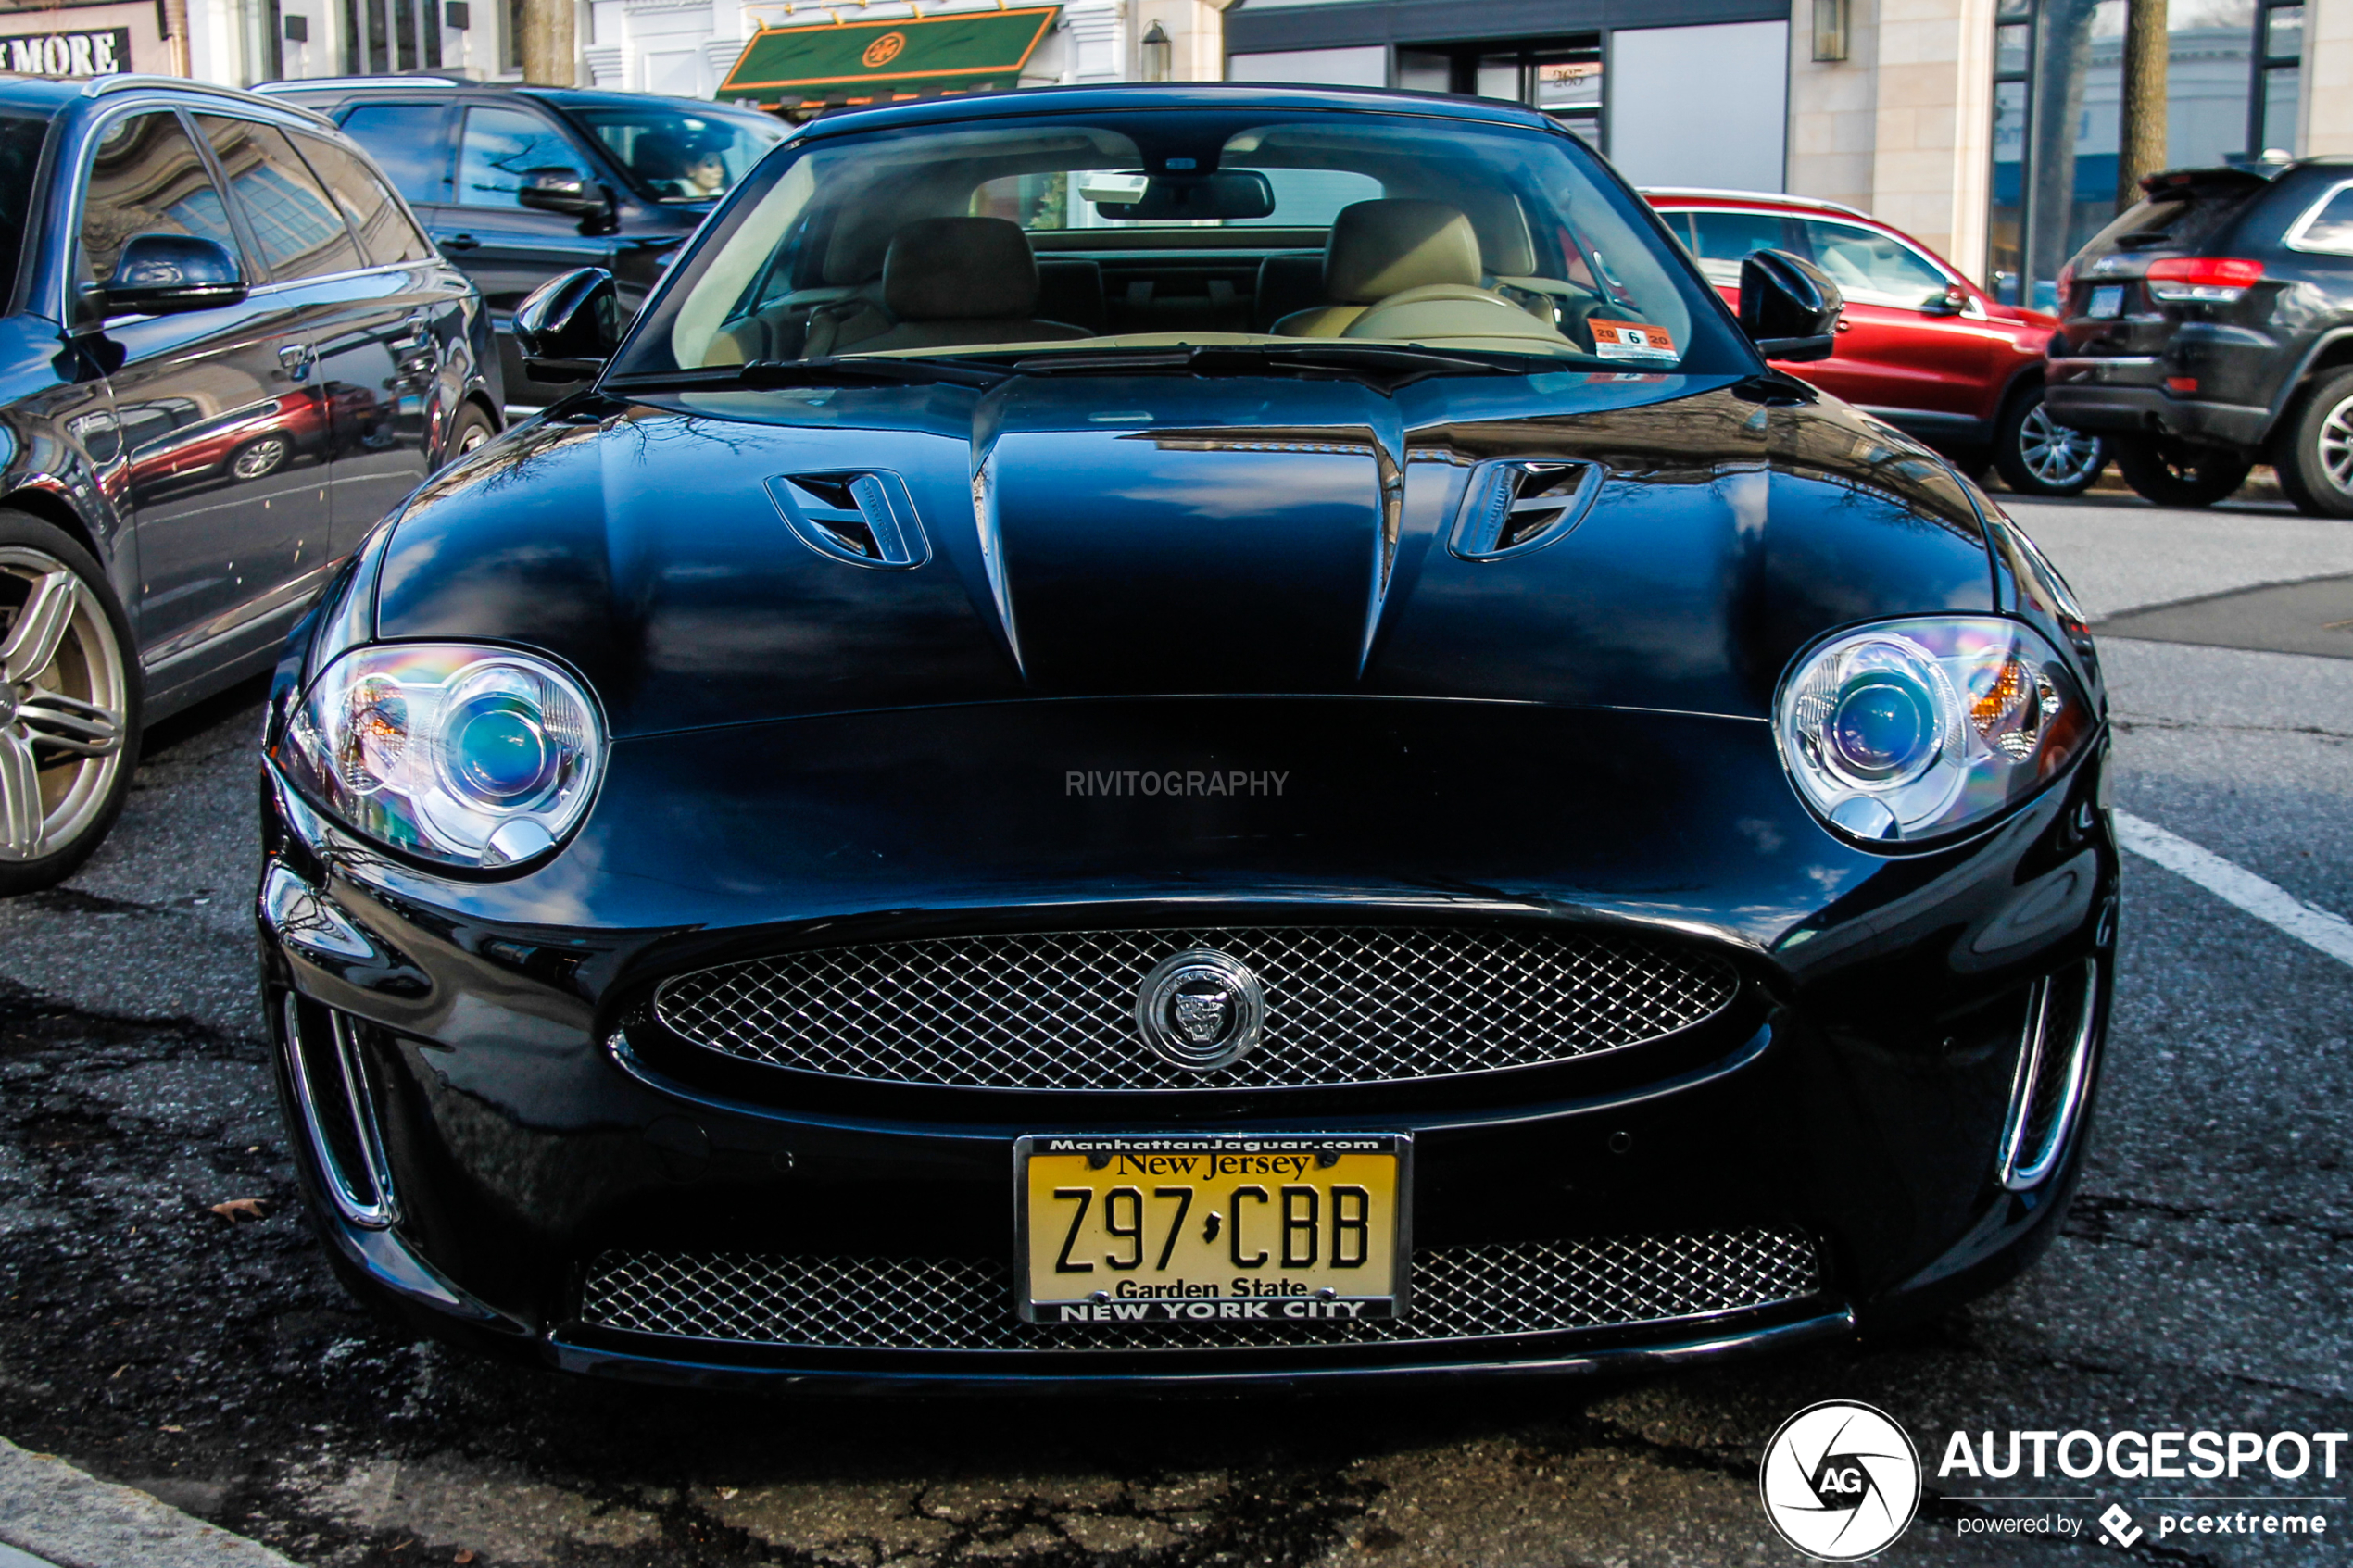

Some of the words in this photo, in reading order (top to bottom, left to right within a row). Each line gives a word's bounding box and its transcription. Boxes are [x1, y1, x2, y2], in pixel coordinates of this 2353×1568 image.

[9, 32, 120, 76] MORE
[1629, 332, 1641, 344] 6
[1650, 335, 1668, 345] 20
[1049, 1139, 1378, 1151] ManhattanJaguar.com
[1116, 1154, 1199, 1175] New
[1202, 1154, 1311, 1181] Jersey
[1053, 1185, 1194, 1273] Z97
[1229, 1185, 1369, 1269] CBB
[1115, 1279, 1219, 1298] Garden
[1231, 1277, 1308, 1298] State
[1060, 1303, 1150, 1322] NEW
[1161, 1301, 1270, 1320] YORK
[1283, 1301, 1365, 1319] CITY
